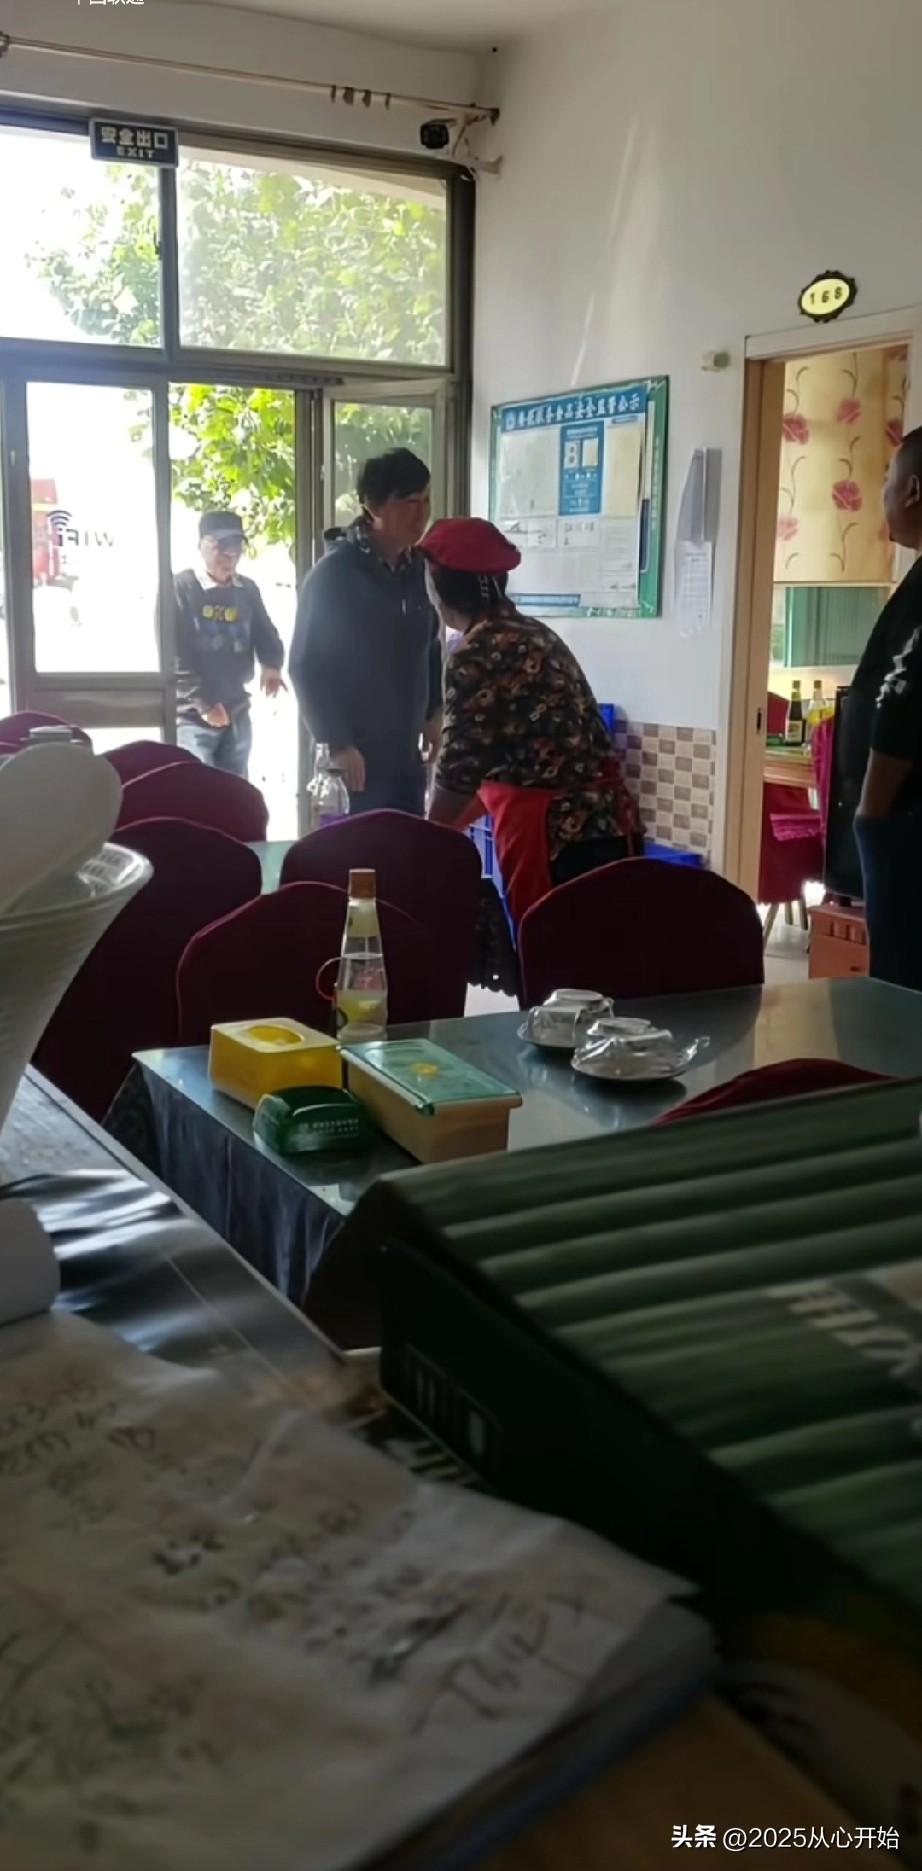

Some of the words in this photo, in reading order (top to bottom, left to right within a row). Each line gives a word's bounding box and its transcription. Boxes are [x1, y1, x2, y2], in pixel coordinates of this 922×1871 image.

[101, 126, 168, 150] 安全出口
[116, 145, 155, 159] EXIT
[809, 286, 843, 305] 168
